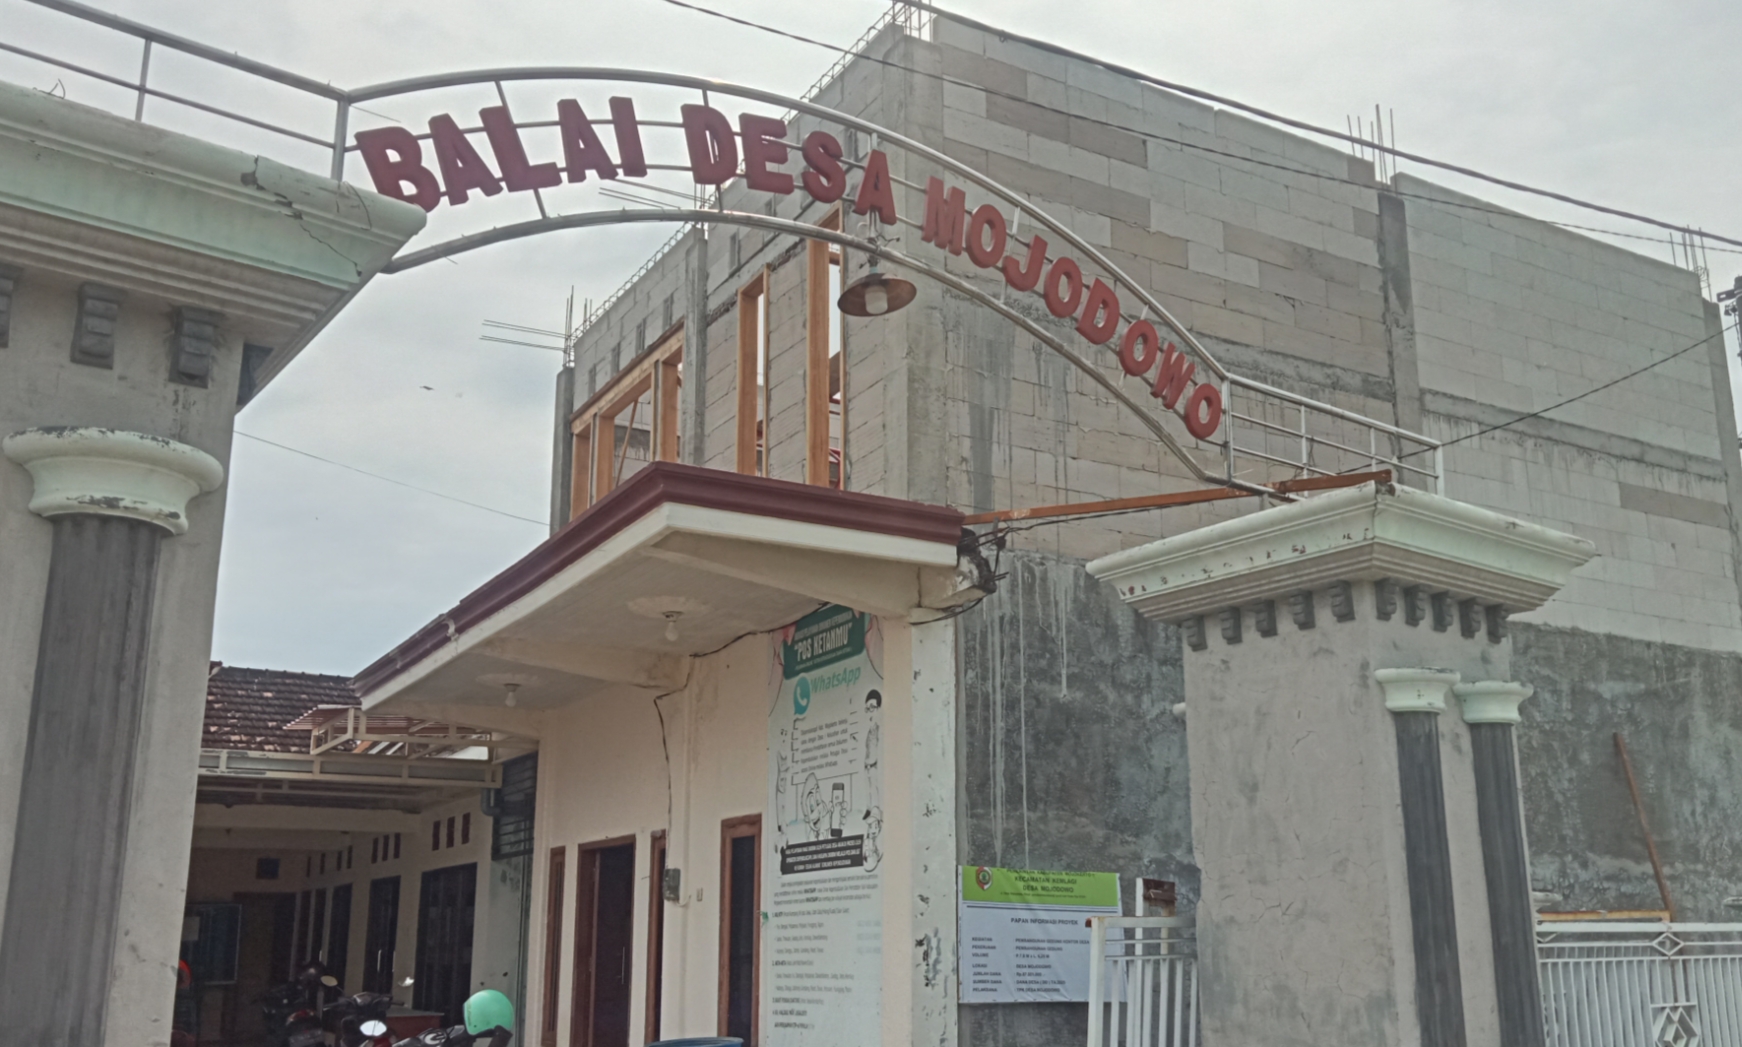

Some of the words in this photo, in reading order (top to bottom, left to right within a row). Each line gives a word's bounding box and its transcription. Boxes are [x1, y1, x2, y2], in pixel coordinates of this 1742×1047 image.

[354, 95, 649, 213] BALAI
[680, 103, 897, 226] DESA
[921, 175, 1223, 441] MOJODOWO
[810, 666, 861, 694] WhatsApp
